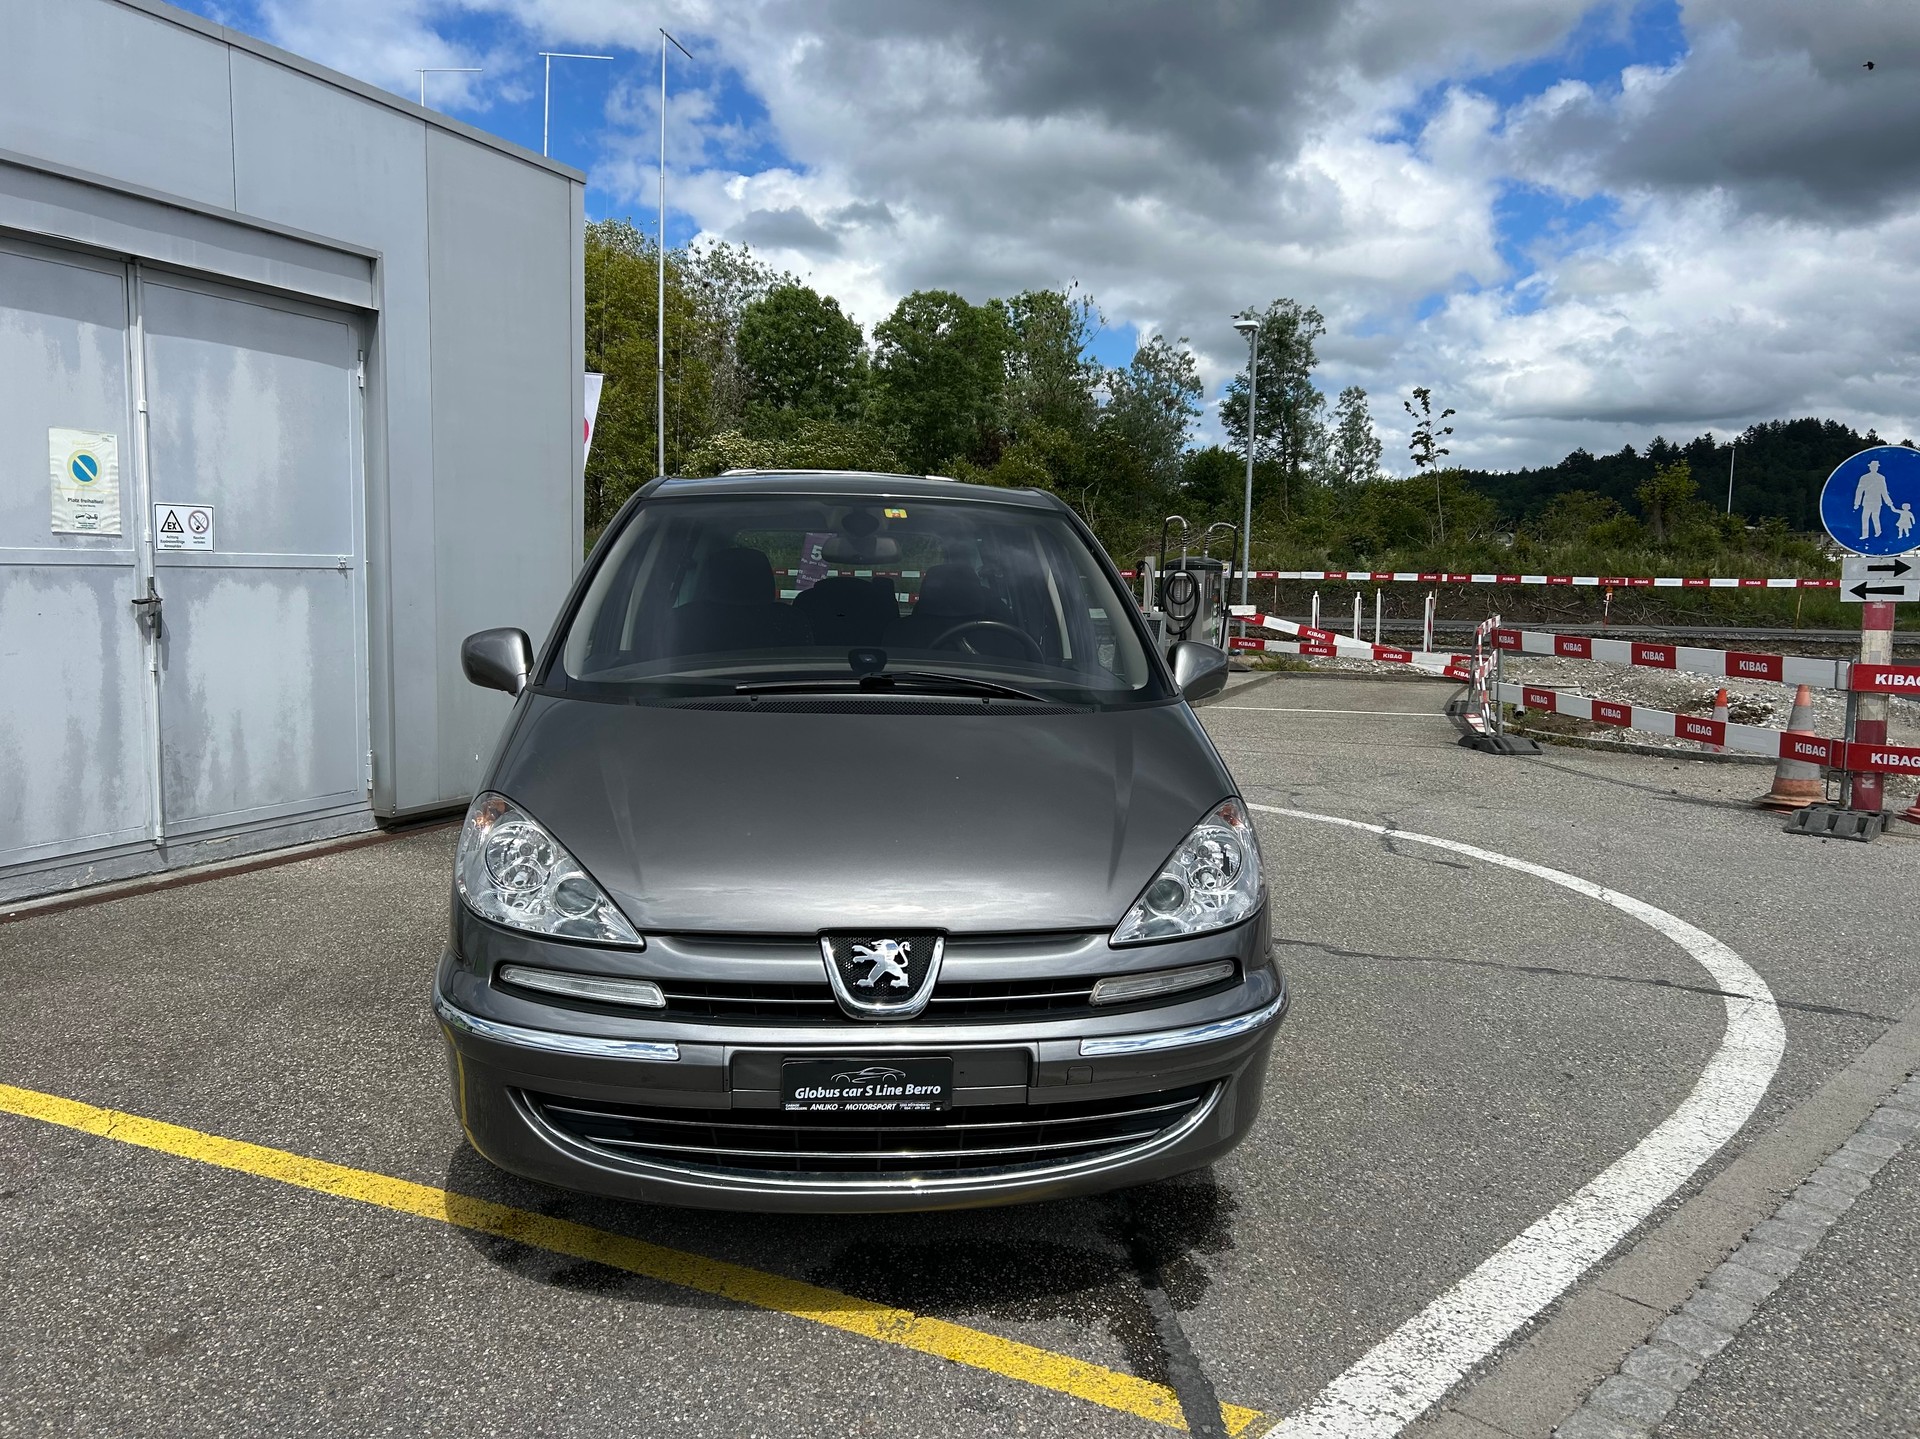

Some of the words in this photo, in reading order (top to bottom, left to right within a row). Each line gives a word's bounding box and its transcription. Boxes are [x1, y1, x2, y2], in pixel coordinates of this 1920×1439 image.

[167, 521, 177, 530] EX
[1307, 630, 1326, 640] KIBAG
[1499, 635, 1515, 645] KIBAG
[1309, 646, 1328, 654] KIBAG
[1562, 642, 1582, 652] KIBAG
[1382, 652, 1403, 660] KIBAG
[1641, 650, 1665, 662] KIBAG
[1739, 660, 1768, 673] KIBAG
[1530, 694, 1548, 705] KIBAG
[1600, 707, 1621, 719] KIBAG
[1686, 723, 1712, 737] KIBAG
[1795, 742, 1826, 757] KIBAG
[795, 1086, 840, 1099] Globus
[842, 1087, 863, 1097] car
[865, 1084, 874, 1096] S
[875, 1084, 903, 1096] Line
[905, 1083, 941, 1095] Berro
[845, 1103, 897, 1111] MOTORSPORT
